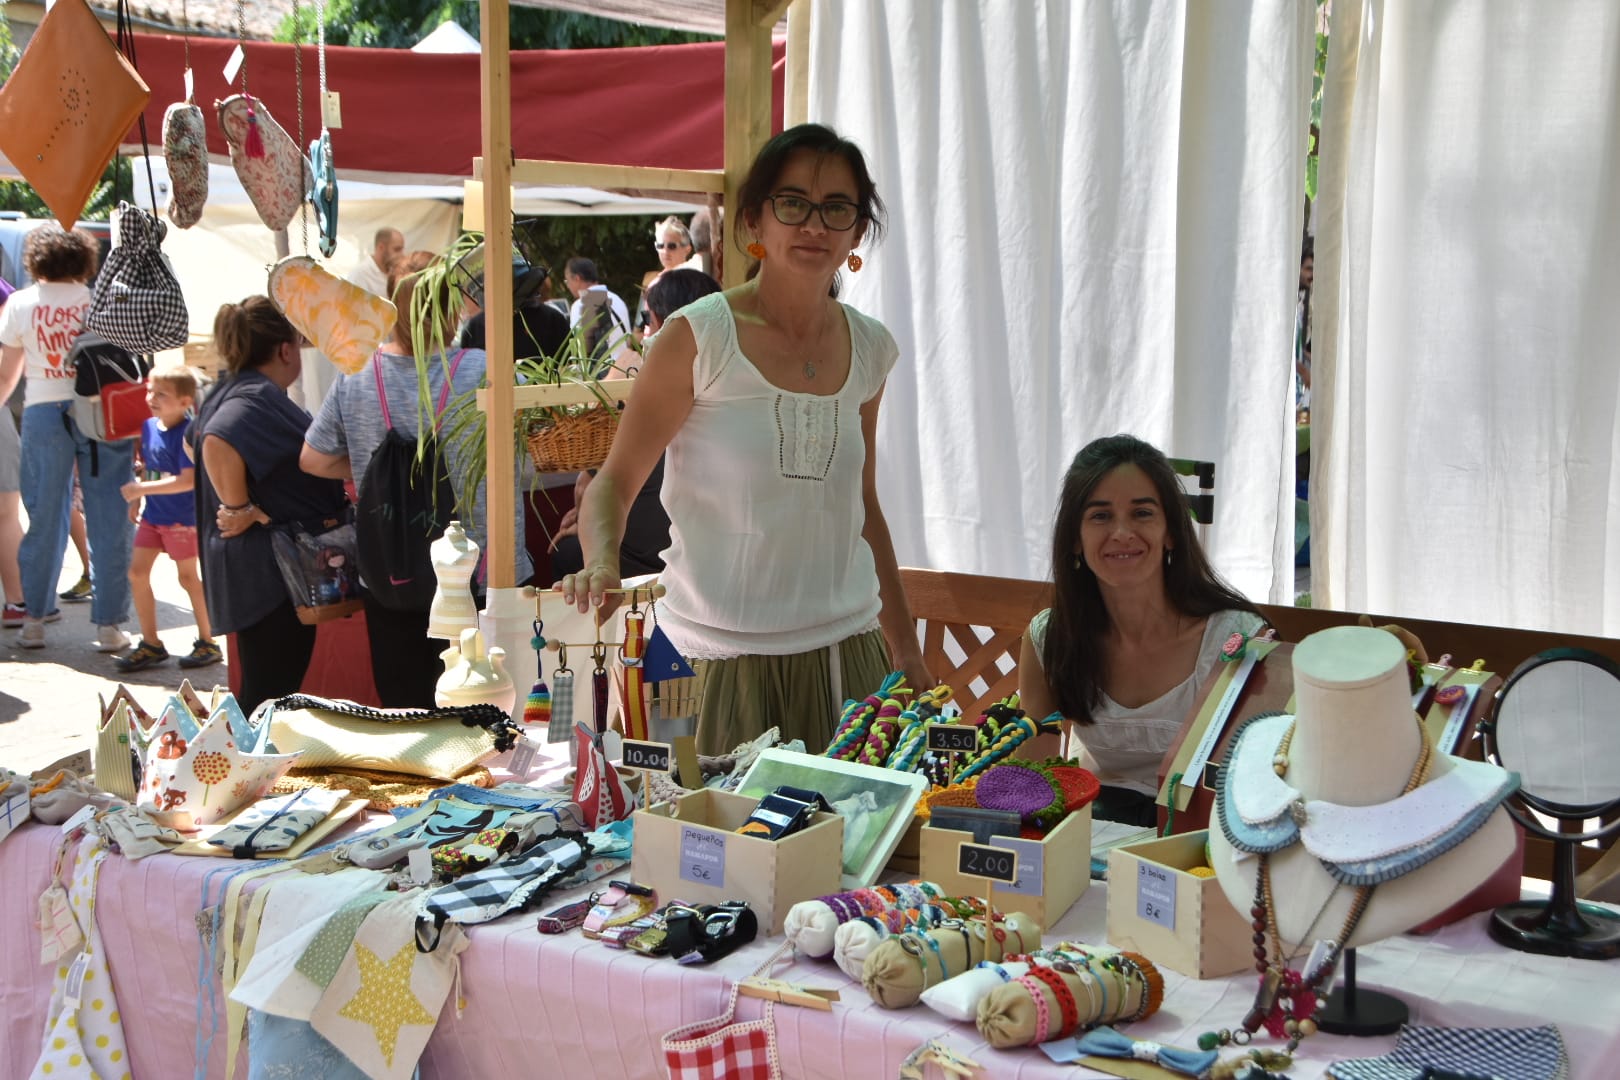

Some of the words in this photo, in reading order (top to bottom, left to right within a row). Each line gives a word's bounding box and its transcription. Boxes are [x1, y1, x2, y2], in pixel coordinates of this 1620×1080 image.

[936, 732, 973, 748] 3.50
[627, 749, 668, 767] 10.00
[967, 850, 1009, 873] 2.00
